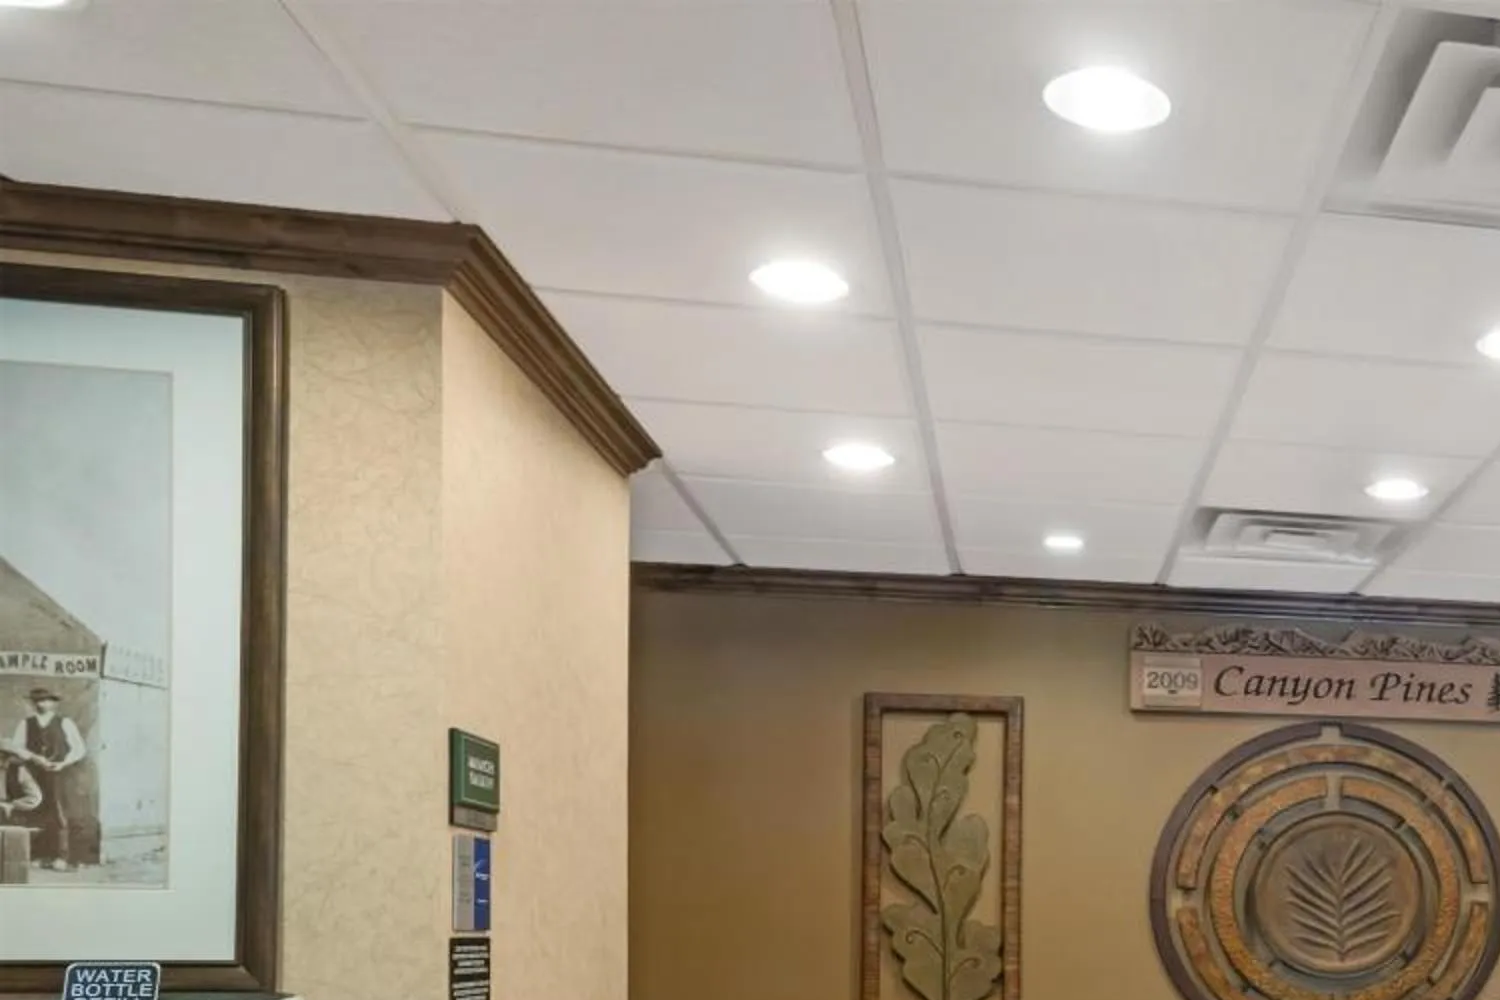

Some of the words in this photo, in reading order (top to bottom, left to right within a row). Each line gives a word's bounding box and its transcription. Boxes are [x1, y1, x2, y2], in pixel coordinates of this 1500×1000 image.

[54, 657, 97, 675] ROOM
[1146, 670, 1199, 691] 2009
[1213, 665, 1357, 706] Canyon
[1369, 671, 1473, 705] Pines
[75, 969, 152, 983] WATER
[71, 983, 153, 997] BOTTLE
